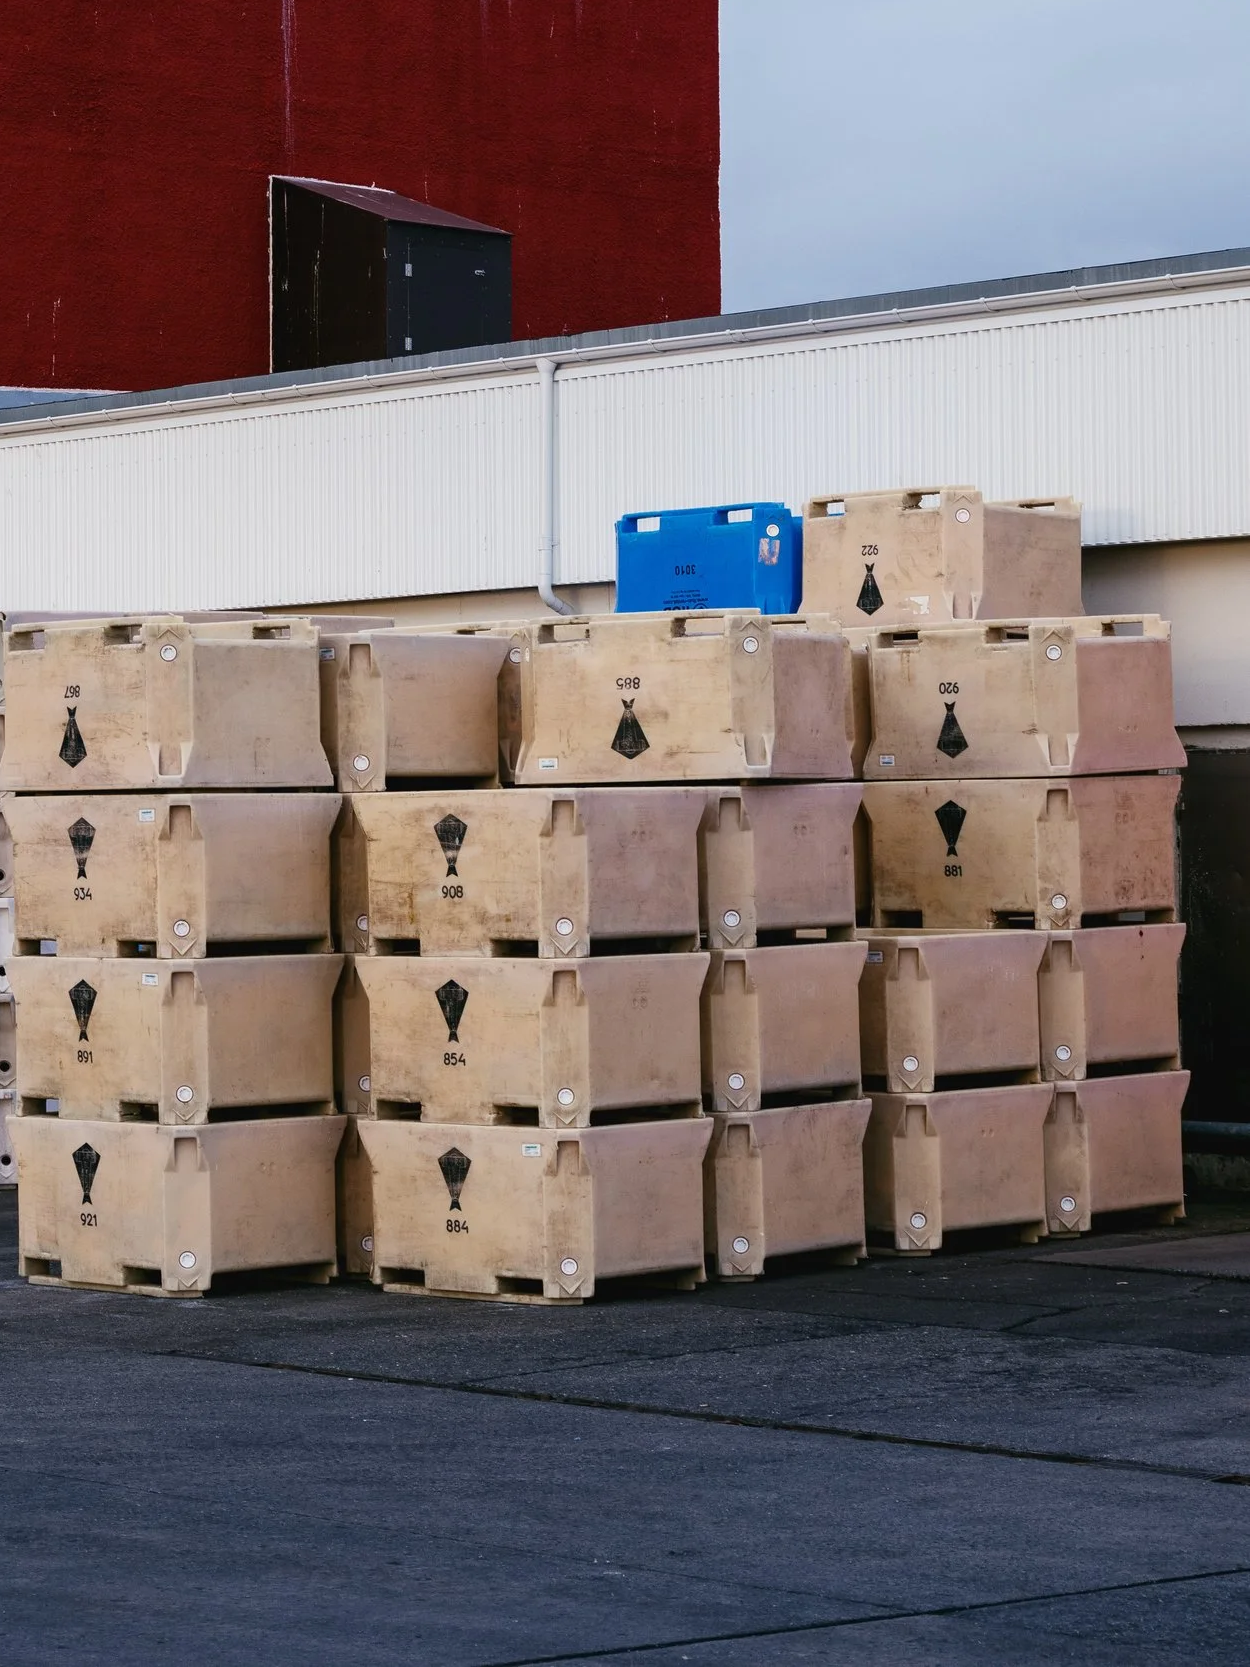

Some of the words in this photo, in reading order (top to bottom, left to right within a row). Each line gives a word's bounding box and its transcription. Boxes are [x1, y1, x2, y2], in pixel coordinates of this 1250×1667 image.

[861, 544, 879, 556] 922
[674, 564, 696, 576] 3010
[616, 676, 641, 690] 885
[938, 682, 960, 695] 920
[64, 685, 81, 699] 867
[944, 865, 963, 877] 881
[73, 887, 92, 901] 934
[441, 885, 464, 899] 908
[77, 1050, 94, 1063] 891
[443, 1052, 466, 1066] 854
[80, 1213, 98, 1227] 921
[446, 1219, 469, 1234] 884
